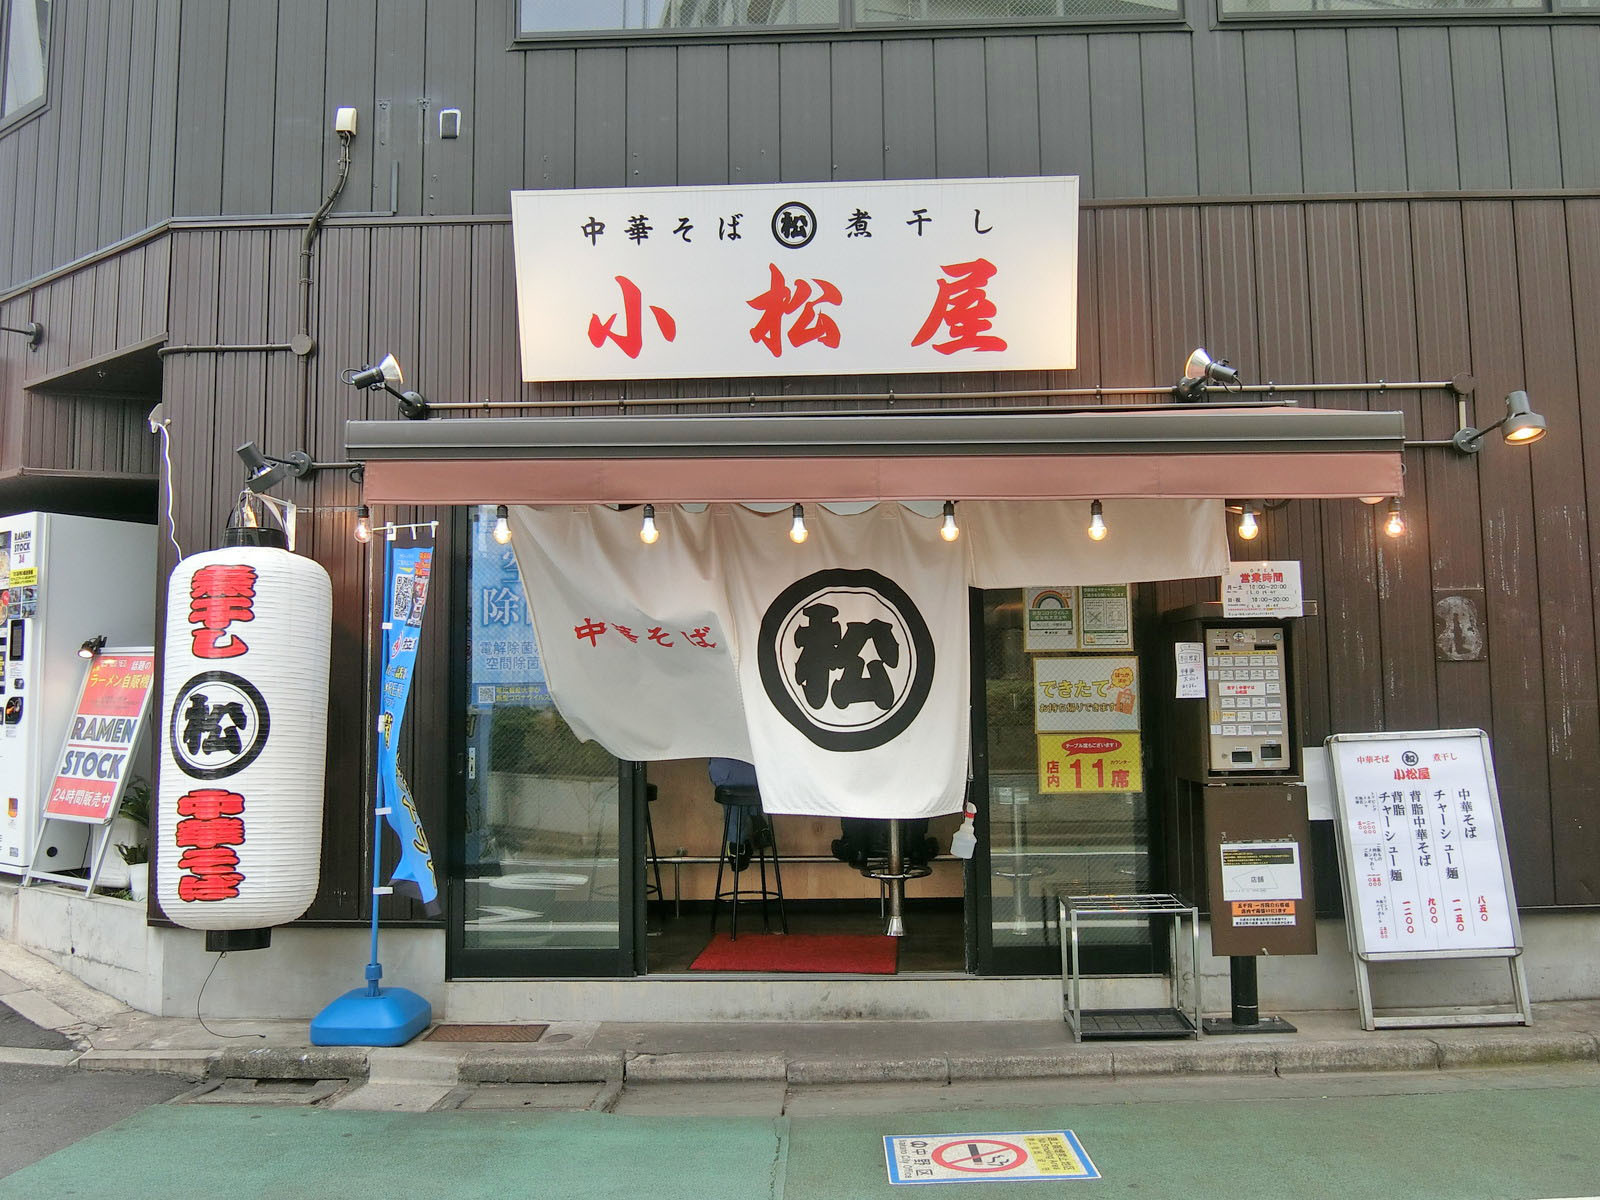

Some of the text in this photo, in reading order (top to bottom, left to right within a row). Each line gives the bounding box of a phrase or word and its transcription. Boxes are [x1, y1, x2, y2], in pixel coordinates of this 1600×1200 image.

[580, 214, 742, 247] 中華そば
[780, 210, 809, 240] 松
[847, 207, 995, 239] 煮干し
[587, 257, 1008, 360] 小松屋
[1239, 572, 1284, 584] 営業時間
[89, 673, 151, 689] ラーメン自販機
[1039, 680, 1109, 699] できたて
[70, 716, 138, 744] RAMEN
[61, 750, 126, 780] STOCK
[1356, 754, 1390, 764] 中華そば
[1433, 752, 1458, 762] 煮干し
[1046, 760, 1060, 788] 店内
[1069, 758, 1105, 788] 11
[1111, 769, 1130, 788] 席
[1393, 767, 1431, 781] 小松屋
[52, 788, 112, 807] 24時間販売中
[1391, 790, 1406, 817] 背脂
[1457, 788, 1477, 839] 中華そば
[1378, 791, 1404, 883] チャーシュー麺
[1409, 790, 1432, 868] 背脂中華そば
[1433, 789, 1460, 880] チャーシュー麺
[911, 1148, 934, 1177] 中野区
